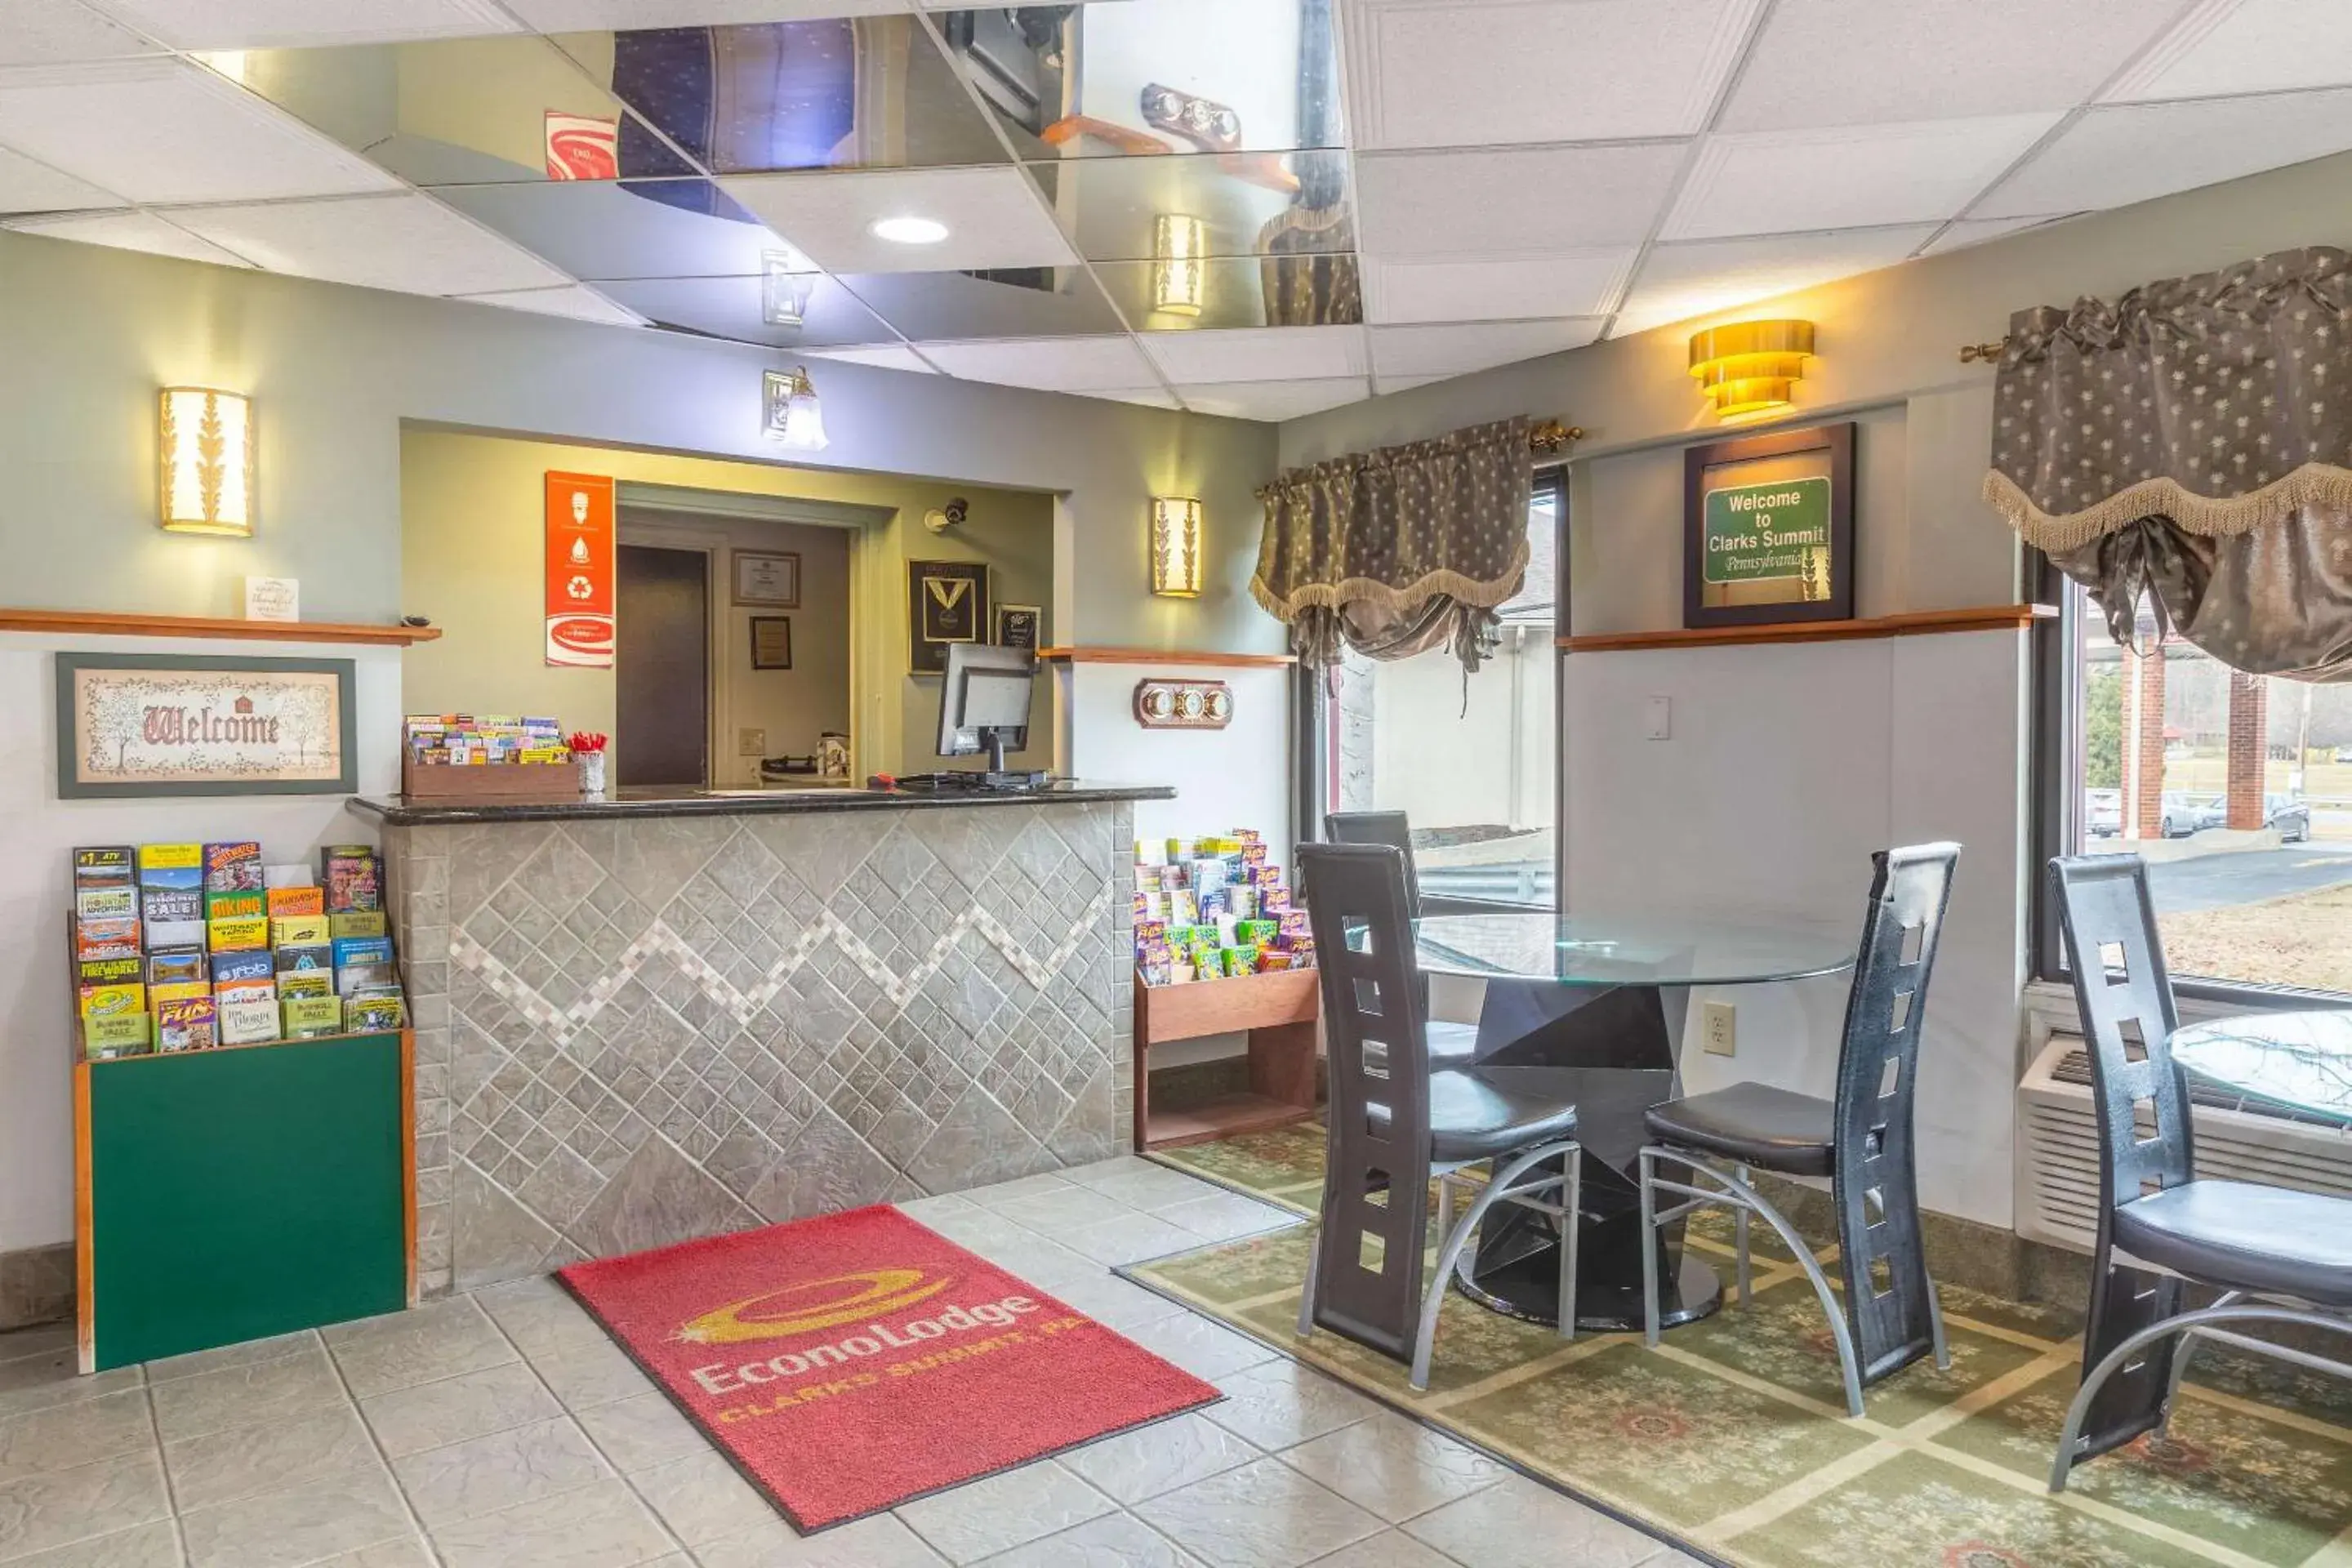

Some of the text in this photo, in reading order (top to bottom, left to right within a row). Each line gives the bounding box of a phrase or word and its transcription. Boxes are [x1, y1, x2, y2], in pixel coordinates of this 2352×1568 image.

[1729, 492, 1801, 513] Welcome
[1756, 513, 1771, 528] to
[1709, 526, 1825, 552] Clarks Summit
[1726, 549, 1802, 574] Pennsylvania
[143, 703, 280, 746] Welcome
[148, 902, 197, 915] SALE!
[213, 920, 262, 933] WHITEWATER
[82, 965, 139, 978] FIREWORKS
[719, 1372, 879, 1423] CLARKS
